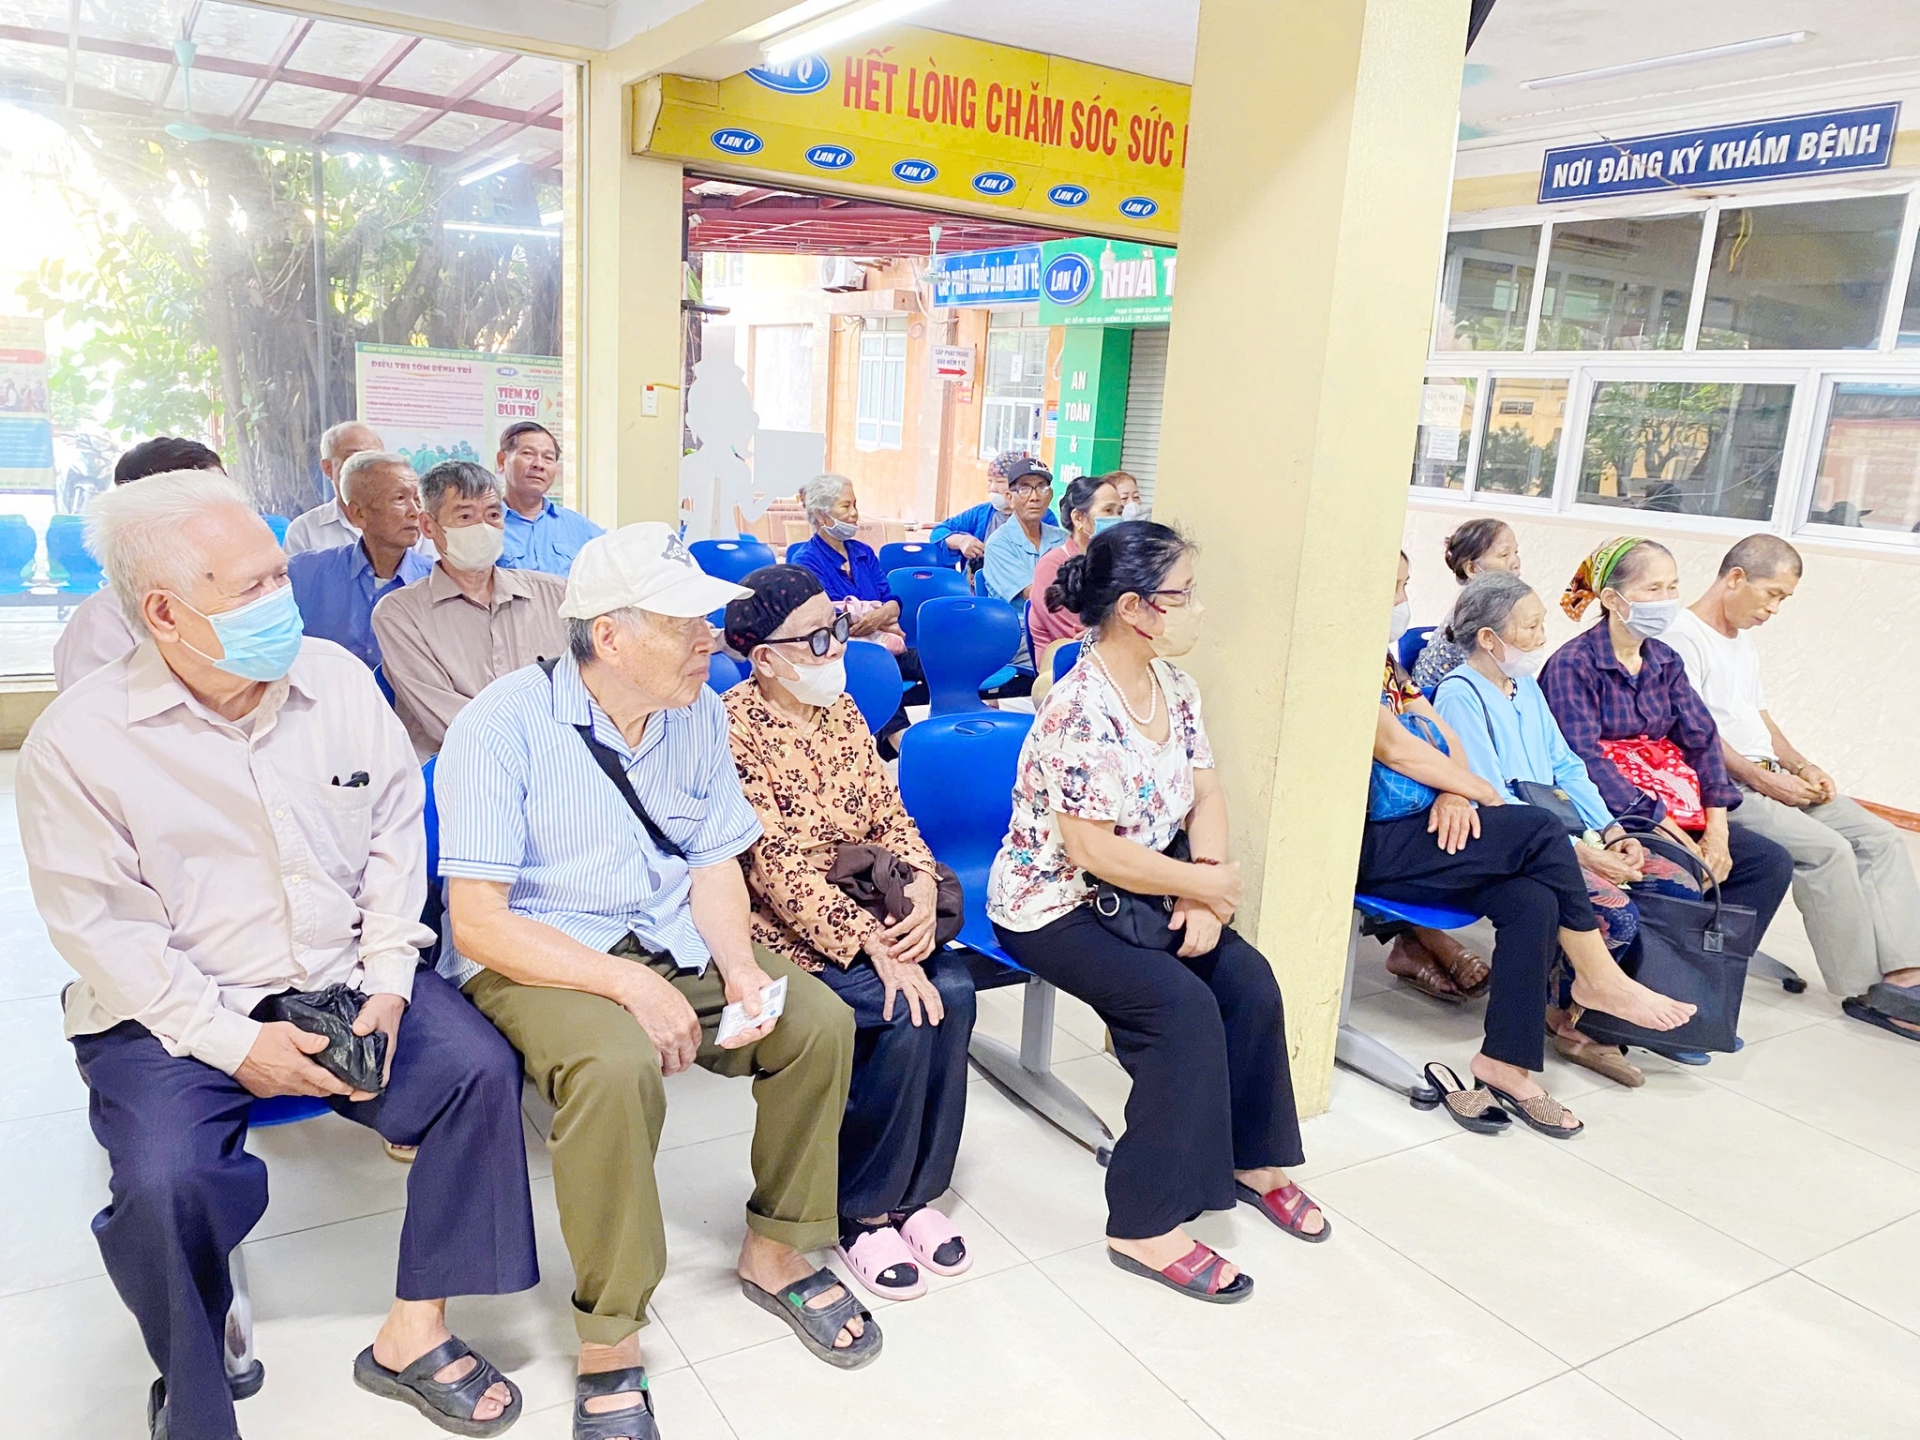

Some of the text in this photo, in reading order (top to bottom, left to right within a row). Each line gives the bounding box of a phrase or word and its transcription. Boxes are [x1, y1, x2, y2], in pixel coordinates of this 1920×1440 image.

[843, 45, 898, 115] HẾT
[906, 56, 977, 129] LÒNG
[985, 80, 1065, 147] CHĂM
[1069, 94, 1119, 156] SÓC
[1127, 105, 1175, 168] SỨC
[720, 133, 741, 148] LAN
[813, 149, 835, 163] LAN
[1552, 122, 1882, 189] NƠI ĐĂNG KÝ KHÁM BỆNH
[899, 164, 919, 178] LAN
[979, 176, 998, 190] LAN
[1054, 189, 1074, 202] LAN
[1124, 201, 1144, 214] LAN
[951, 264, 968, 295] PHÁT
[968, 258, 990, 295] THUỐC
[990, 257, 1005, 293] BẢO
[1005, 253, 1024, 291] HIỂM
[1025, 263, 1030, 290] Y
[1030, 253, 1039, 290] TẾ
[1050, 265, 1082, 293] LAN Q
[1101, 249, 1157, 299] NHÀ
[1070, 370, 1087, 391] AN
[1064, 398, 1091, 422] TOÀN
[1069, 434, 1079, 453] &
